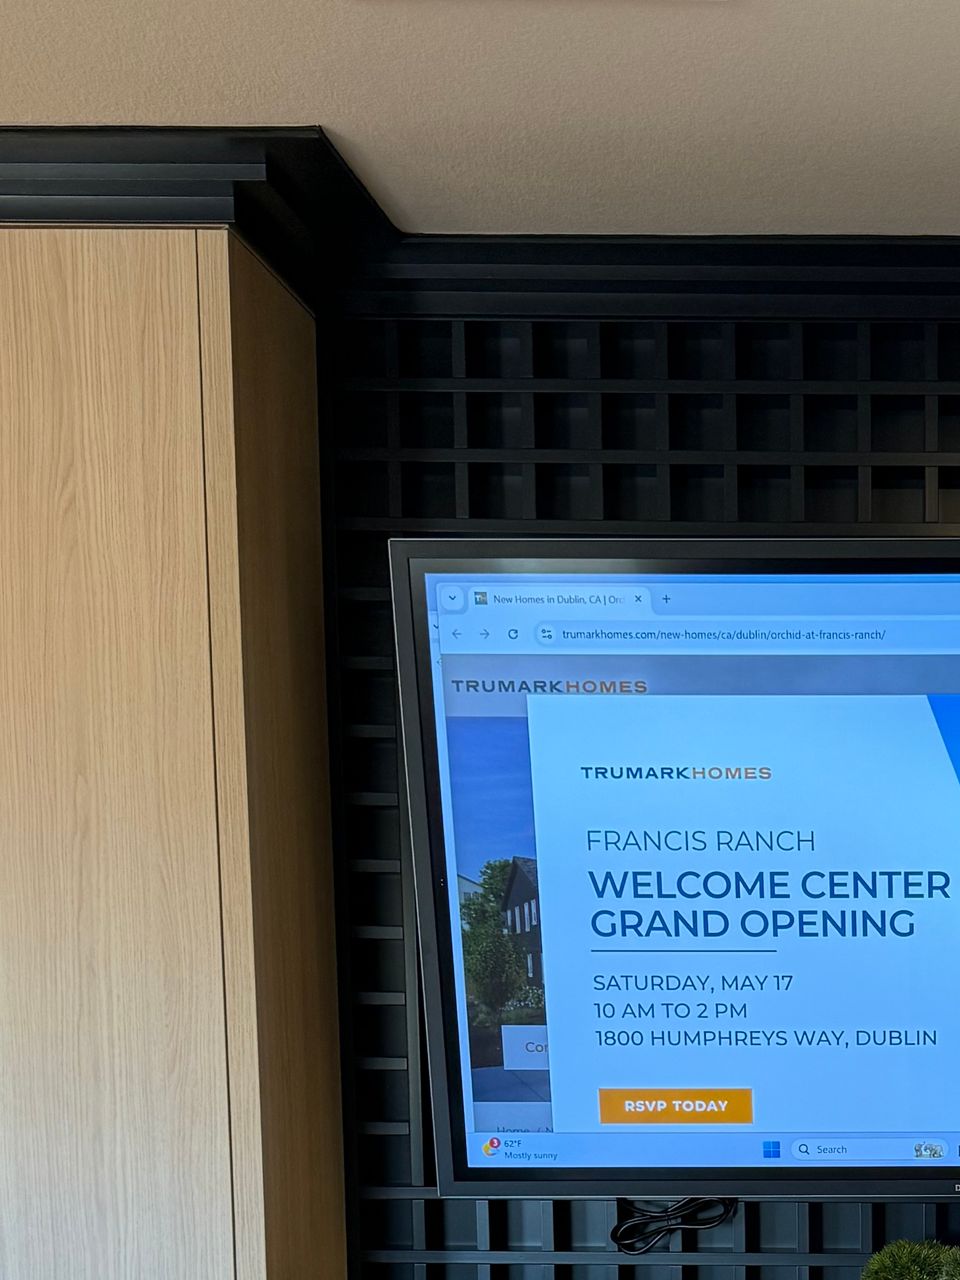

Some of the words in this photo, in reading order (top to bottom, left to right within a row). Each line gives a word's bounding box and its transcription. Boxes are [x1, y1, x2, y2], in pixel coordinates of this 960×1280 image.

[493, 595, 512, 604] New
[514, 594, 545, 604] Homes
[546, 594, 555, 604] in
[557, 594, 587, 606] Dublin,
[589, 595, 602, 604] CA
[562, 628, 886, 642] trumarkhomes.com/new-homes/ca/dublin/orchid-at-francis-ranch/
[451, 679, 648, 694] TRUMARKHOMES
[580, 766, 773, 780] TRUMARKHOMES
[586, 829, 708, 852] FRANCIS
[716, 830, 816, 852] RANCH
[587, 870, 791, 899] WELCOME
[800, 870, 951, 899] CENTER
[590, 909, 730, 938] GRAND
[740, 909, 916, 938] OPENING
[592, 974, 715, 994] SATURDAY,
[720, 975, 770, 992] MAY
[772, 975, 794, 992] 17
[594, 1003, 616, 1020] 10
[621, 1003, 656, 1020] AM
[660, 1003, 692, 1020] TO
[696, 1003, 709, 1020] 2
[714, 1003, 748, 1019] PM
[595, 1030, 644, 1048] 1800
[650, 1030, 788, 1047] HUMPHREYS
[793, 1030, 850, 1049] WAY,
[855, 1029, 938, 1047] DUBLIN
[624, 1100, 668, 1113] RSVP
[672, 1100, 729, 1113] TODAY
[503, 1151, 531, 1161] Mostly
[533, 1152, 558, 1161] sunny
[816, 1143, 848, 1155] Search
